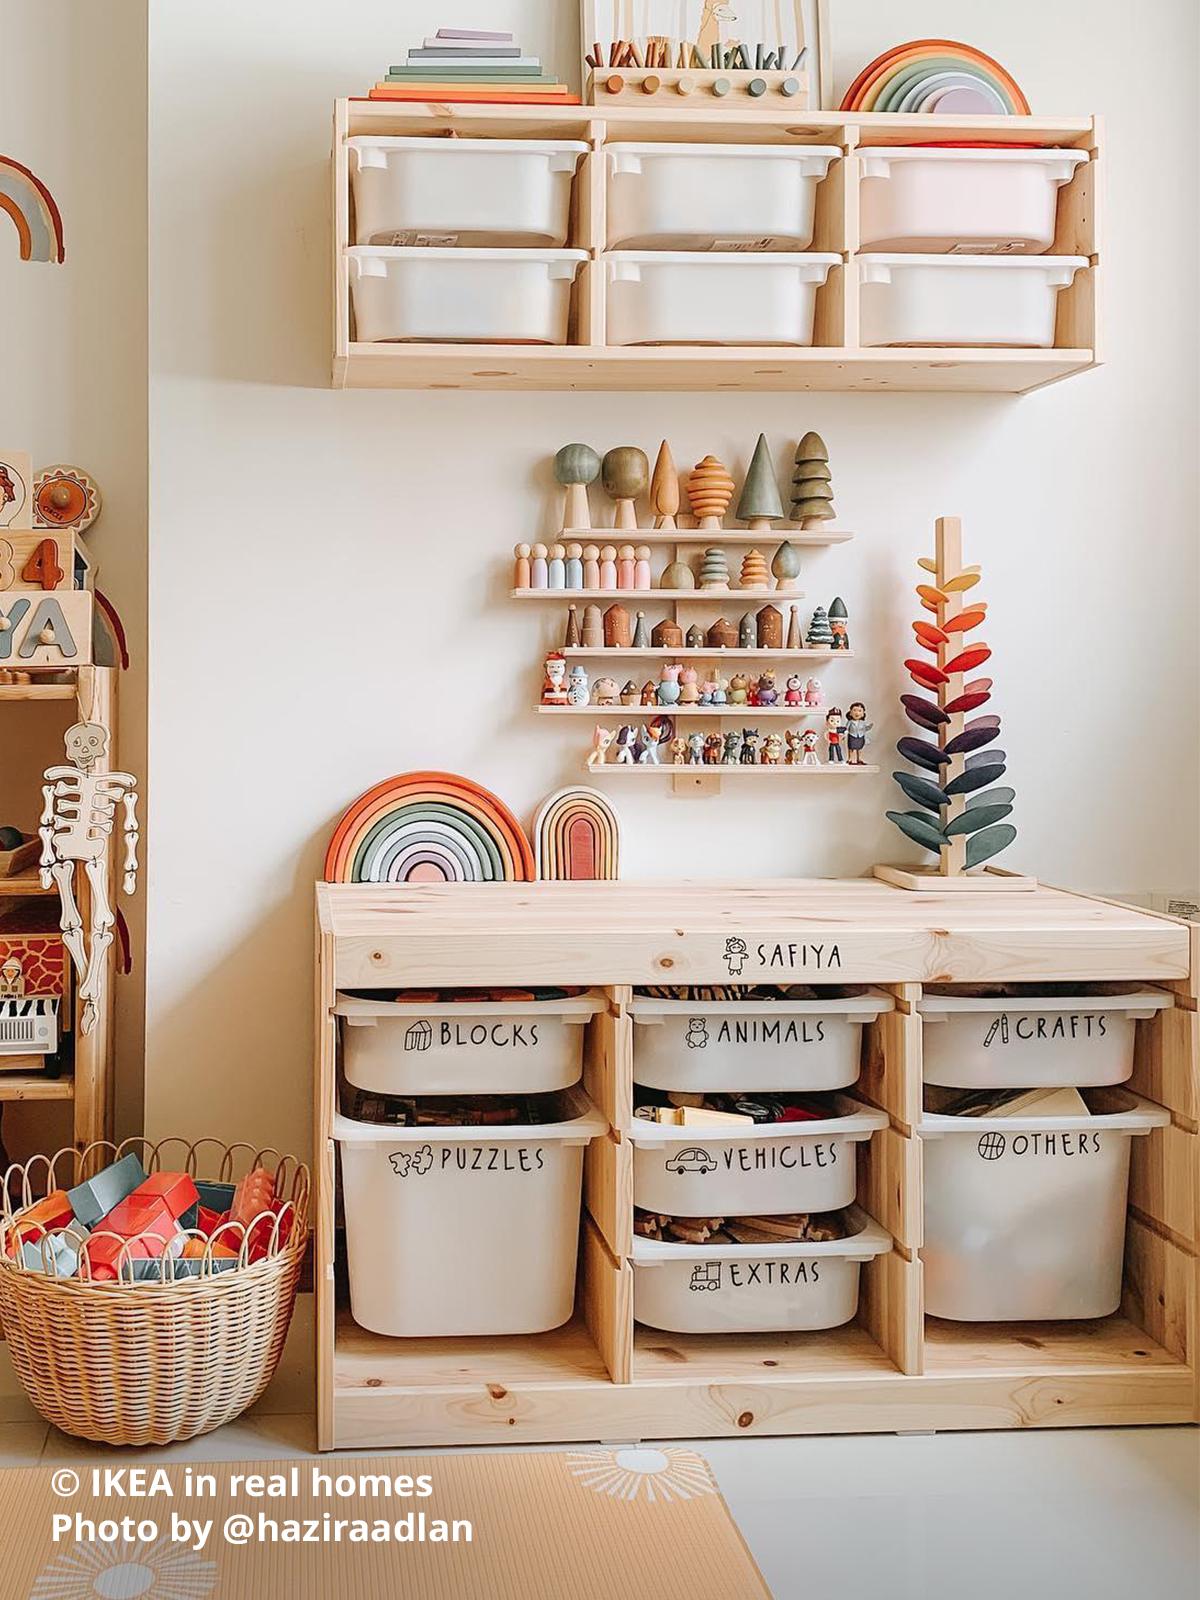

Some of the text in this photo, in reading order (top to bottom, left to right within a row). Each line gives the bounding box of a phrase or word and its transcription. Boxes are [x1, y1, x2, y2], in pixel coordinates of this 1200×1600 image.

[757, 943, 841, 969] SAFIYA
[440, 1021, 538, 1047] BLOCKS
[717, 1020, 825, 1043] ANIMALS
[1015, 1014, 1107, 1040] CRAFTS
[1012, 1131, 1101, 1156] OTHERS
[441, 1147, 544, 1172] PUZZLES
[723, 1142, 837, 1172] VEHICLES
[729, 1261, 819, 1287] EXTRAS
